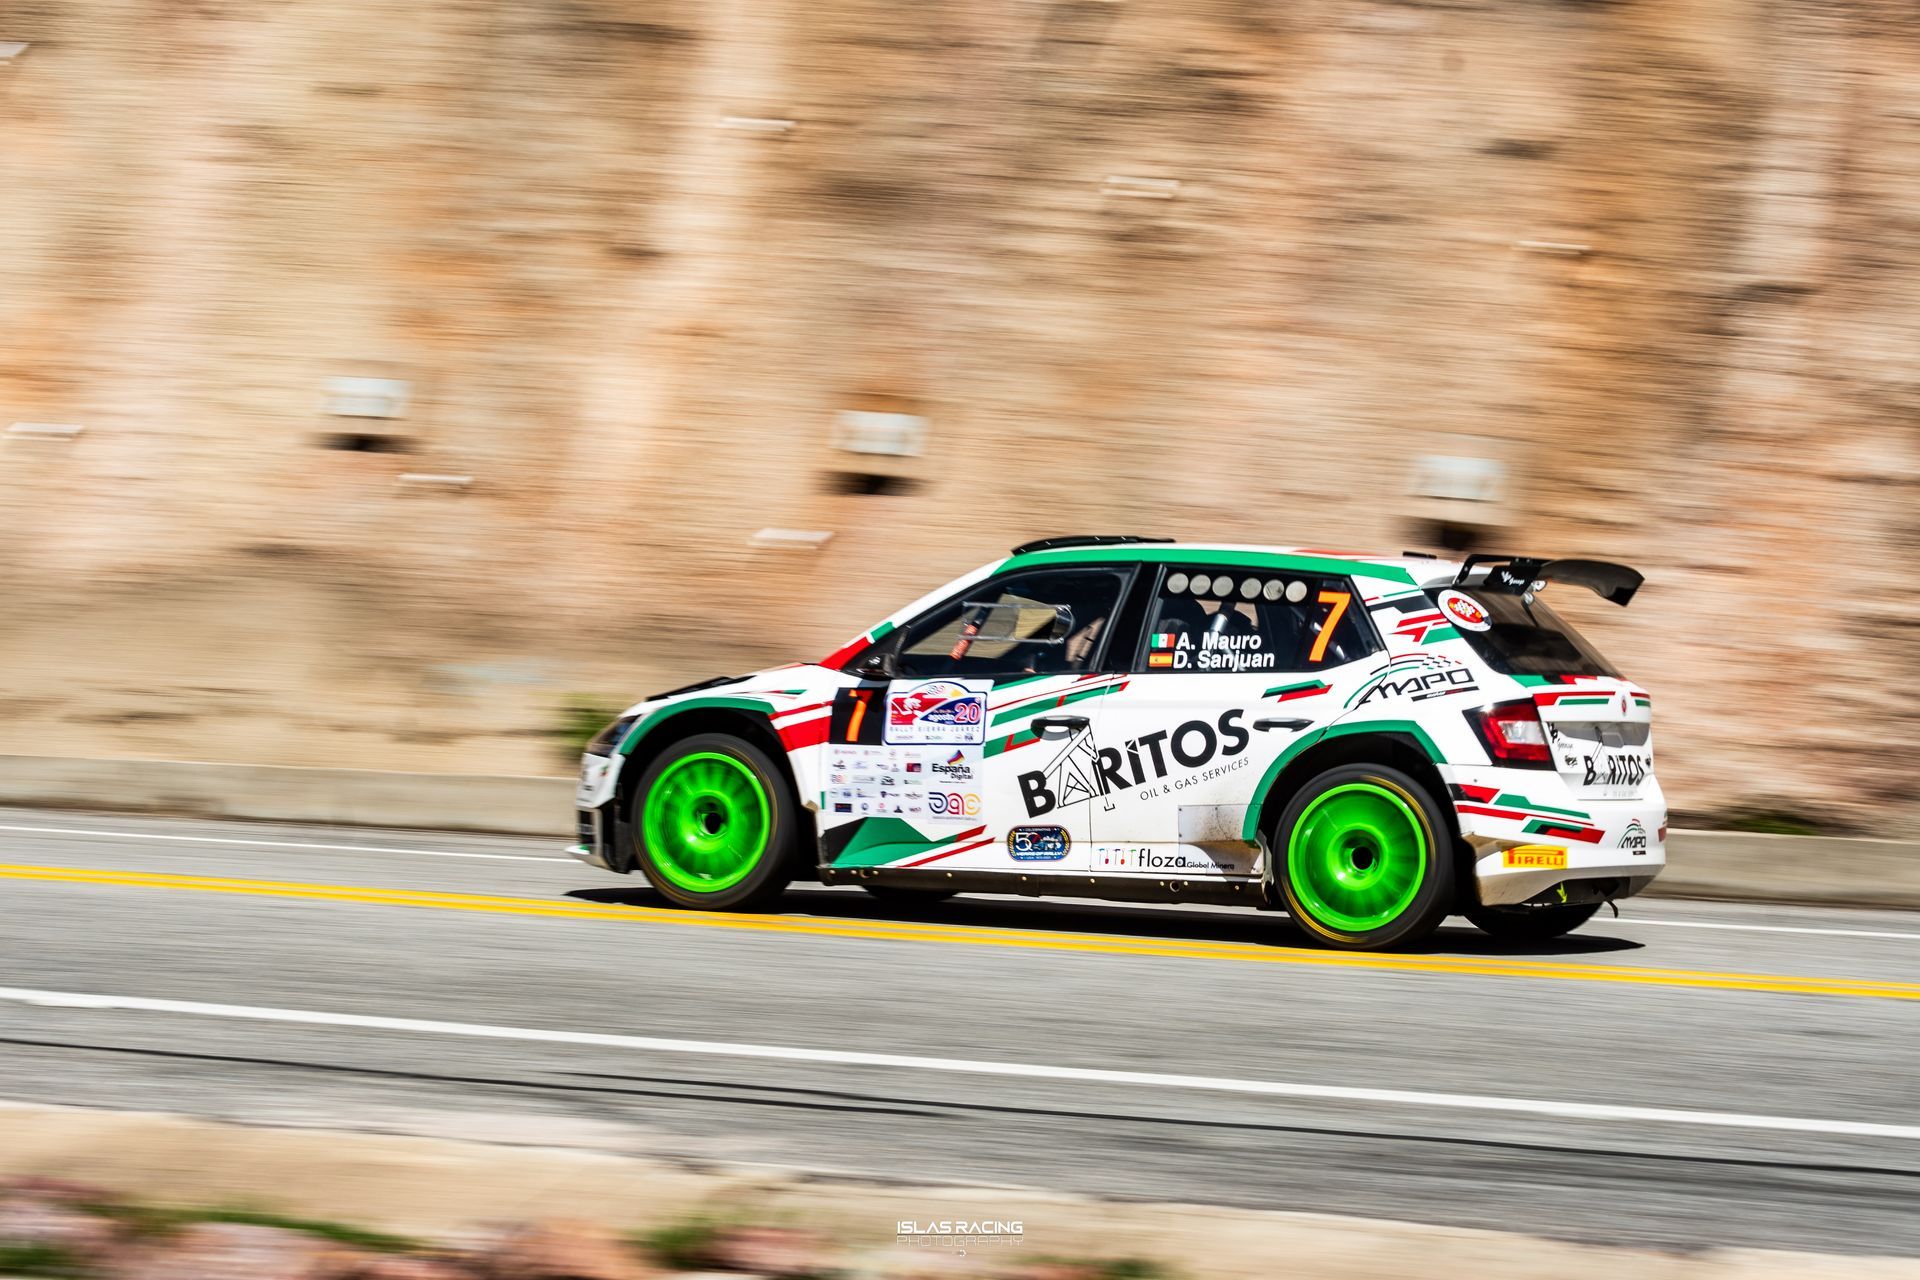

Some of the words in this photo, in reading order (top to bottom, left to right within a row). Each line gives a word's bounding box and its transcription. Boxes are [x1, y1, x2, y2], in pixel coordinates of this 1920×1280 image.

[1308, 591, 1351, 662] 7
[1175, 632, 1196, 650] A.
[1202, 632, 1262, 651] Mauro
[1172, 651, 1192, 669] D.
[1197, 651, 1275, 672] Sanjuan
[953, 703, 980, 724] 20
[931, 763, 971, 775] España
[1140, 788, 1160, 801] OIL
[1163, 784, 1171, 794] &
[1174, 775, 1199, 790] GAS
[1202, 757, 1249, 782] SERVICES
[1138, 848, 1187, 868] floza
[1186, 861, 1210, 869] Global
[1508, 848, 1565, 866] PIRELLI
